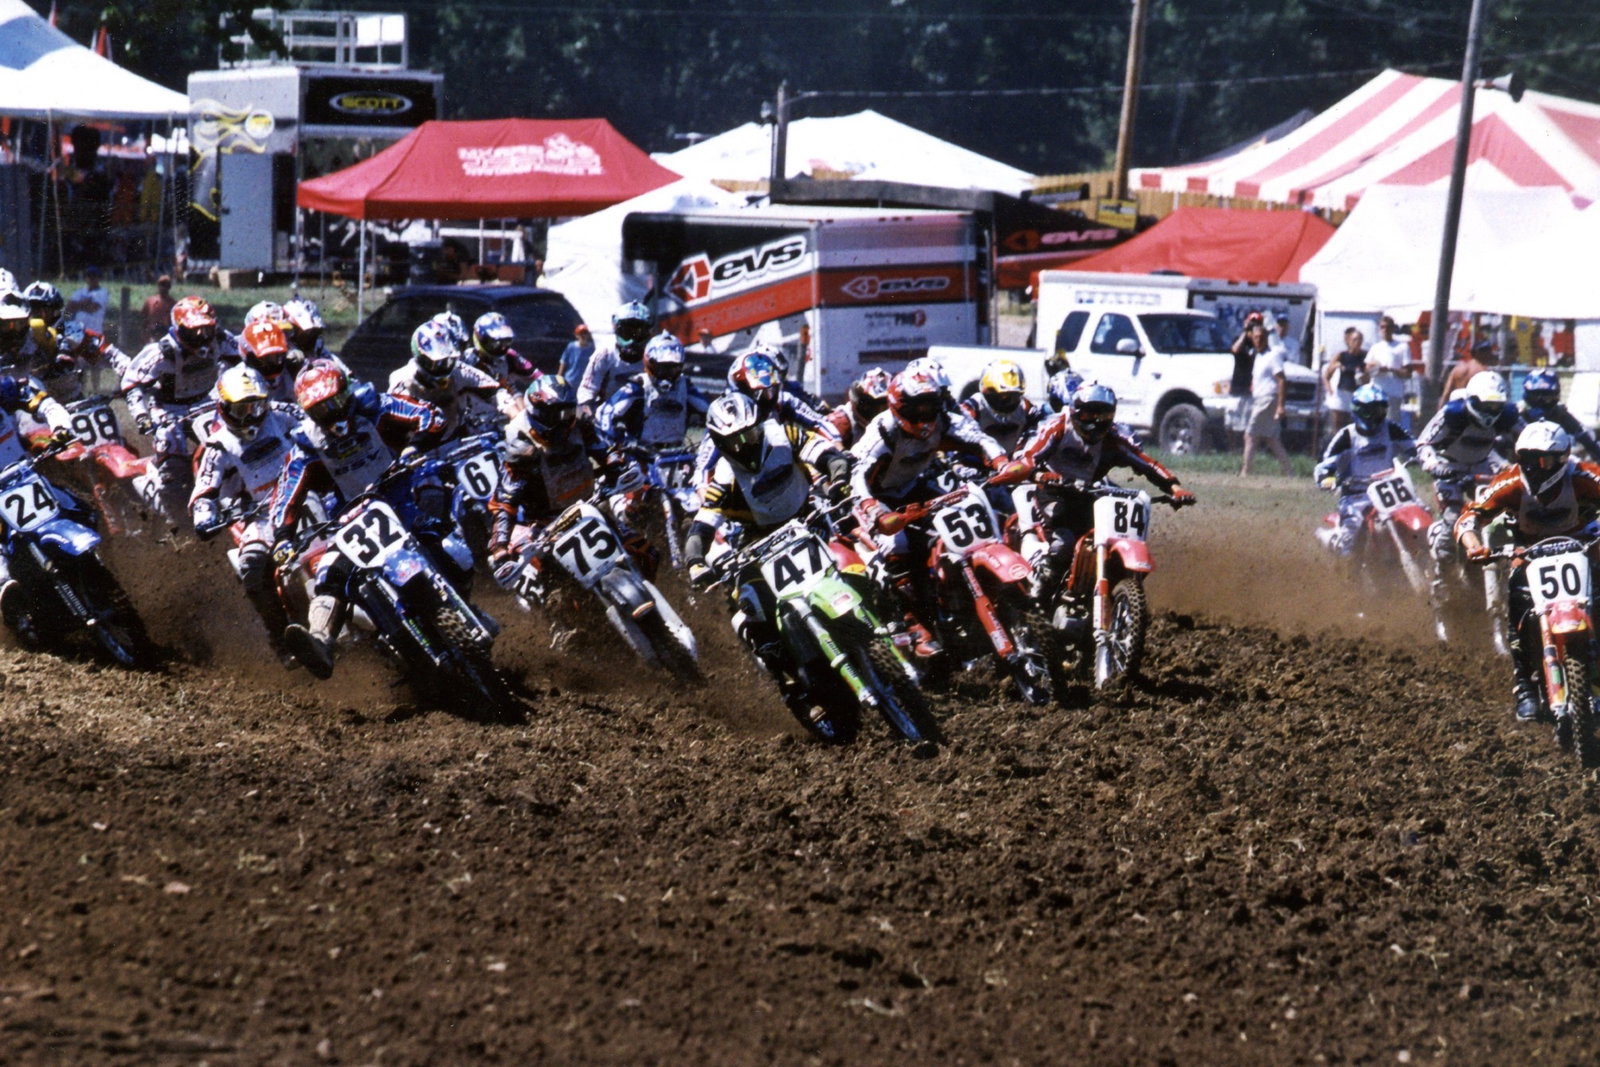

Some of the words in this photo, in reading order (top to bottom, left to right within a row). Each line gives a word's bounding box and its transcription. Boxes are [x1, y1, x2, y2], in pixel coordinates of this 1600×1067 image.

[342, 97, 398, 109] SCOTT
[713, 241, 803, 281] evs
[71, 408, 120, 446] 98
[463, 451, 500, 498] 67
[1376, 476, 1414, 508] 66
[5, 482, 56, 527] 24
[942, 503, 994, 547] 53
[1114, 501, 1146, 537] 84
[343, 508, 403, 565] 32
[556, 518, 618, 577] 75
[773, 536, 823, 592] 47
[1539, 562, 1581, 600] 50
